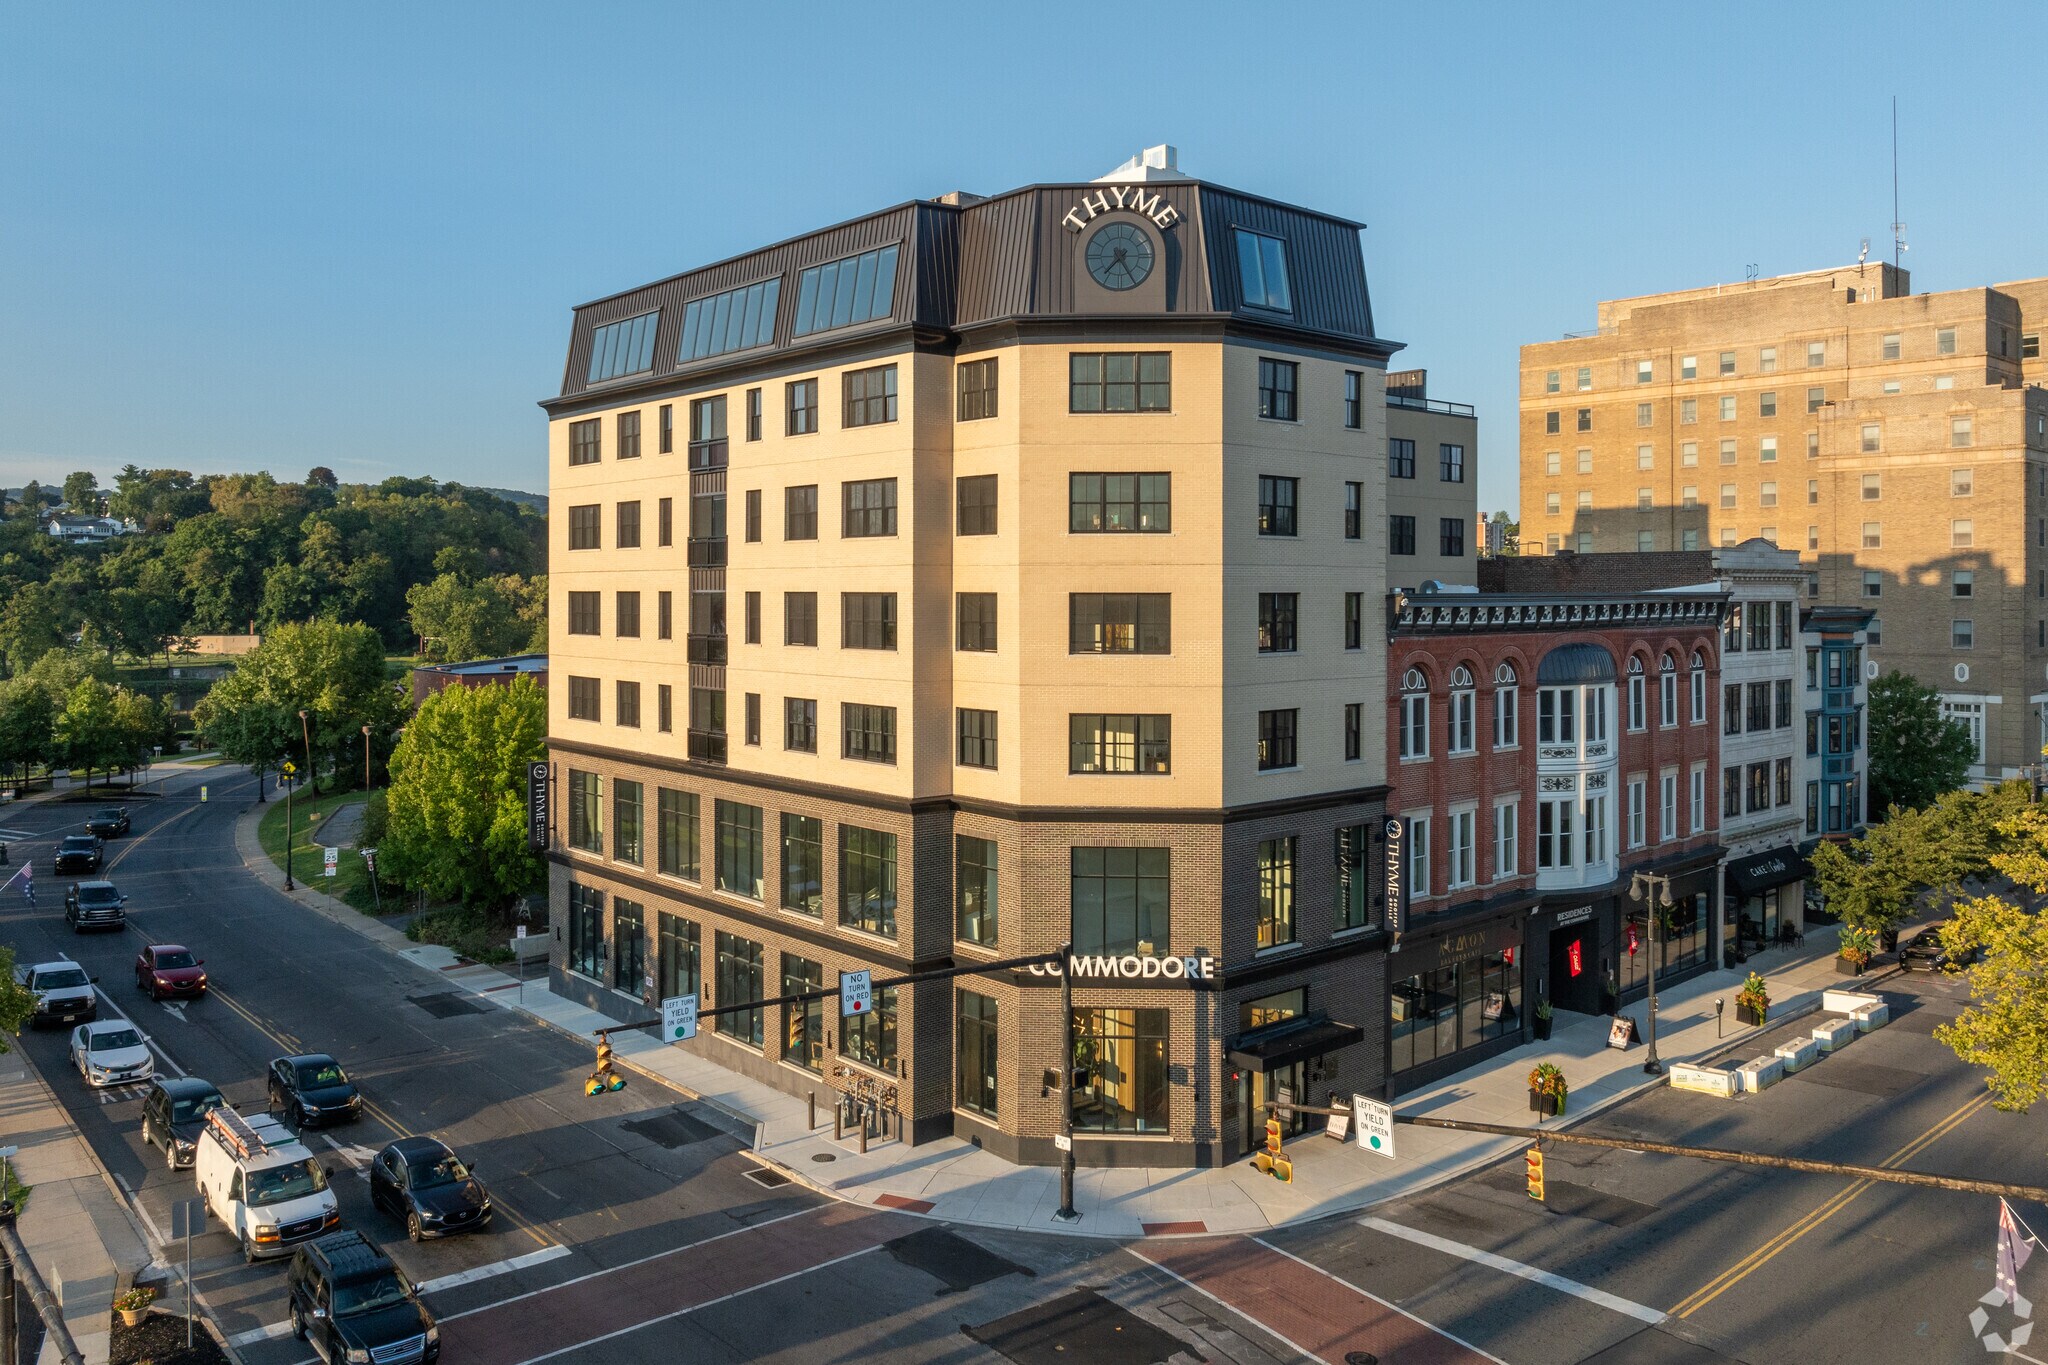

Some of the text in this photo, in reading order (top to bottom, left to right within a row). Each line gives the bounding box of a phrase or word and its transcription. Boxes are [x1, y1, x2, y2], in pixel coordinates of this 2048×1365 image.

[1062, 186, 1179, 229] THYME
[536, 780, 545, 822] THYME
[1388, 842, 1399, 896] THYME
[1557, 905, 1592, 921] RESIDENCES
[850, 974, 862, 983] NO
[849, 984, 865, 992] TURN
[856, 992, 869, 1000] RED
[671, 1007, 689, 1017] YIELD
[677, 1016, 693, 1024] GREEN
[1358, 1100, 1389, 1116] LEFT TURN
[1364, 1112, 1384, 1126] YIELD
[1360, 1122, 1389, 1137] ON GREEN
